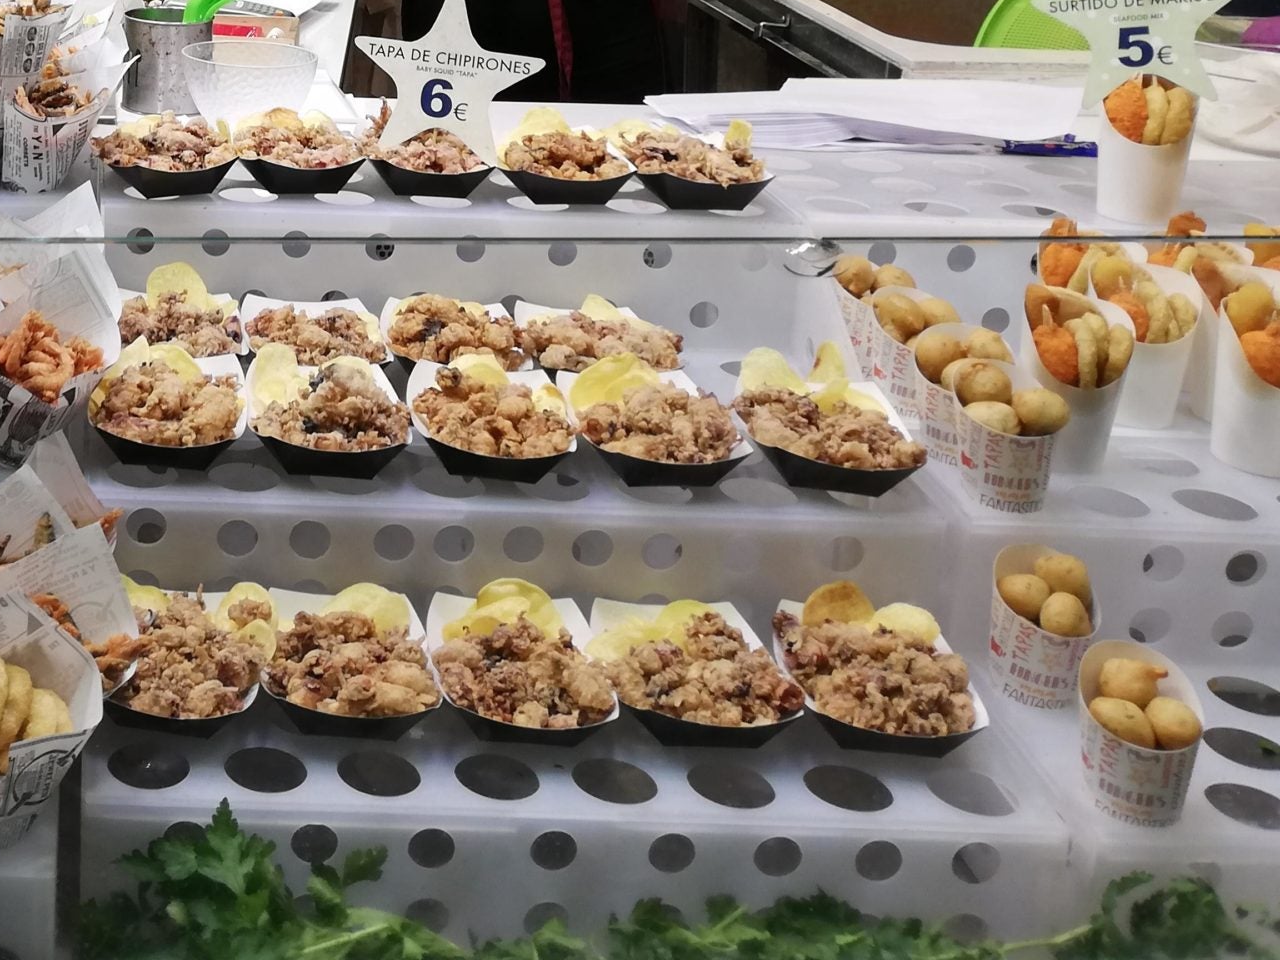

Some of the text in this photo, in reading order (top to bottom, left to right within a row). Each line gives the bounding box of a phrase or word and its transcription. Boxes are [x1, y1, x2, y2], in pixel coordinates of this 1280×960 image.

[1113, 14, 1148, 23] SEAFOOD
[369, 43, 531, 75] TAPA DE CHIPIRONES
[1118, 26, 1174, 68] 5€
[416, 65, 478, 78] BABY SQUID "TAPA"
[420, 78, 468, 121] 6€
[891, 344, 912, 381] TAPAS
[984, 432, 1005, 470] TAPAS
[1011, 623, 1038, 663] TAPAS
